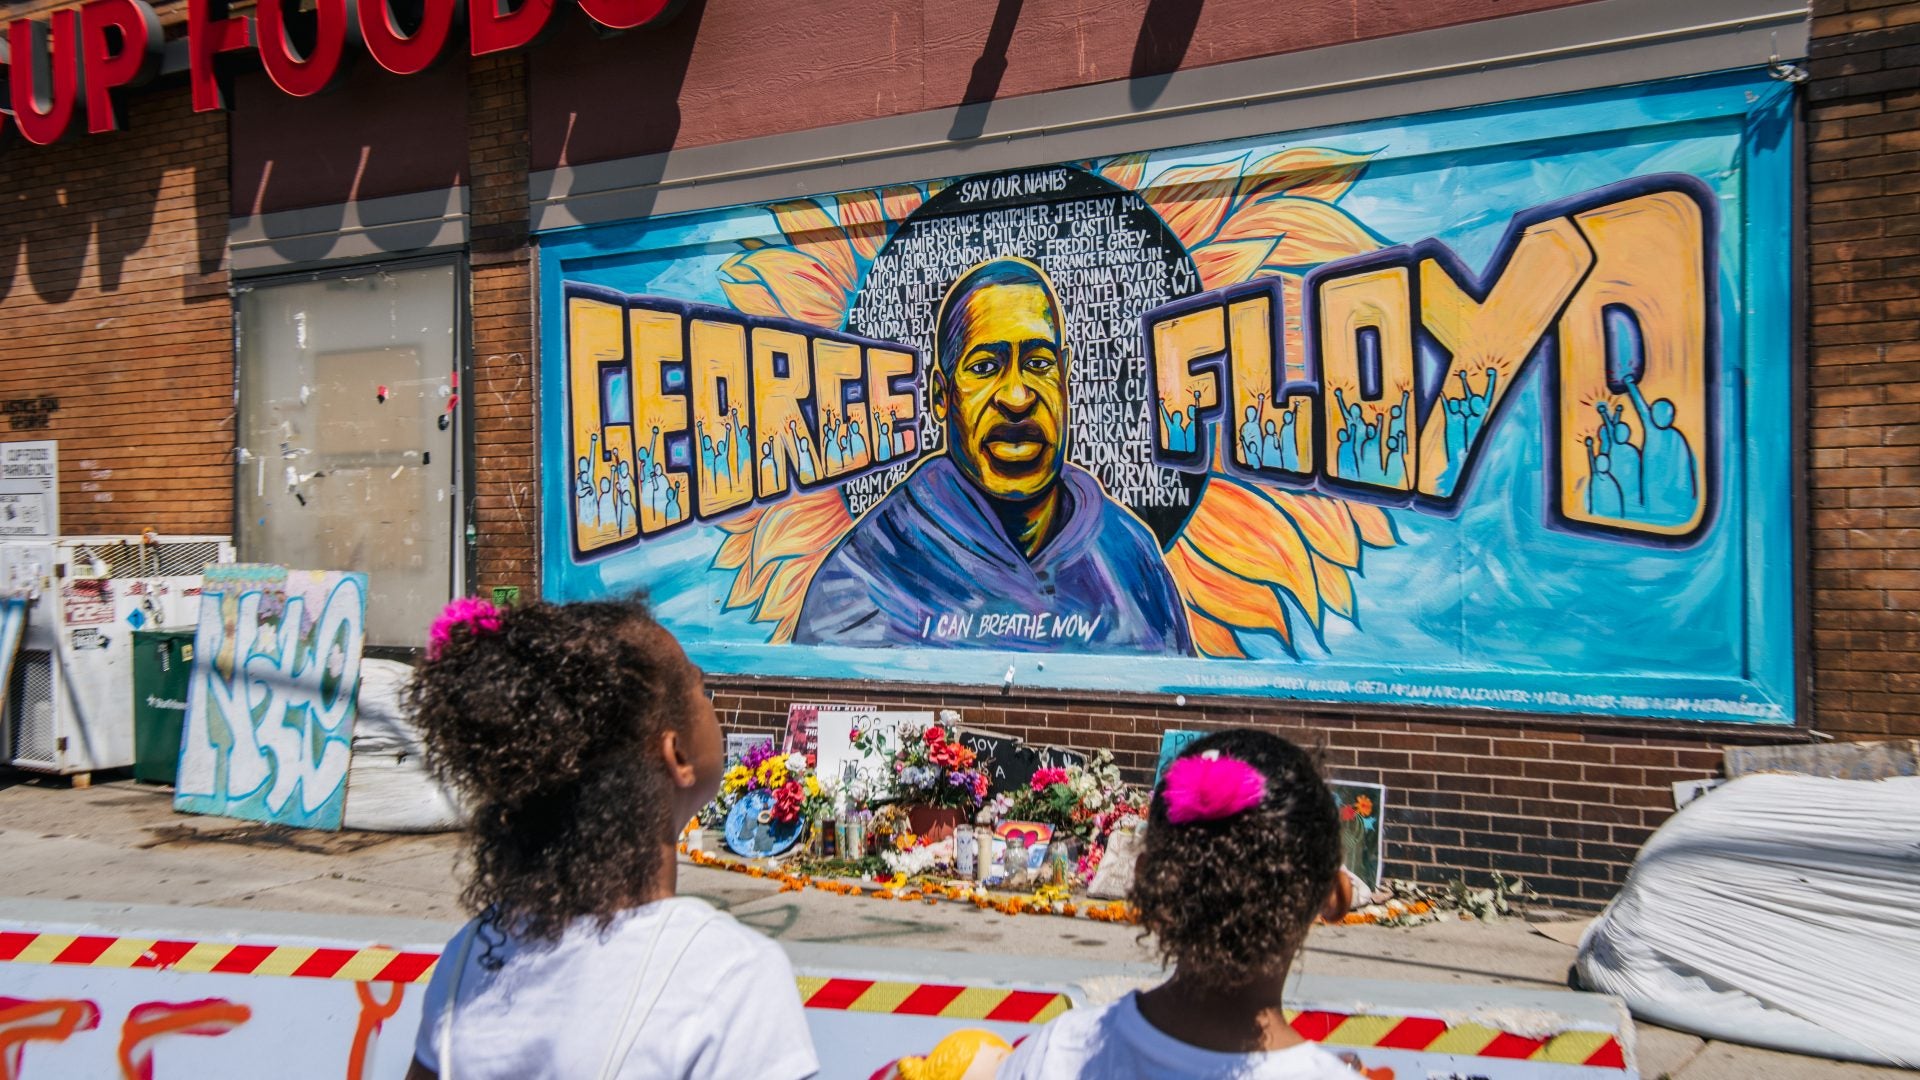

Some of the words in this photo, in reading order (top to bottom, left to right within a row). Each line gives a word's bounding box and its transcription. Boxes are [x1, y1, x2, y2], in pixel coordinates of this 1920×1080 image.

[0, 0, 144, 146] UP
[190, 0, 662, 113] FOO
[960, 179, 990, 203] SAY
[991, 175, 1022, 200] OUR
[1024, 168, 1067, 194] NAMES
[910, 214, 981, 239] TERRENCE
[983, 203, 1051, 230] CRUTCHER
[1055, 197, 1116, 223] JEREMY
[894, 235, 936, 256] TAMIR
[937, 233, 969, 252] RICE
[982, 222, 1058, 244] PHILANDO
[1071, 215, 1129, 237] CASTILE
[872, 254, 899, 274] AKAI
[900, 251, 942, 270] GURLEY
[942, 245, 991, 266] KENDRA
[991, 240, 1036, 258] JAMES
[1046, 234, 1106, 257] FREDDIE
[1107, 229, 1146, 250] GREY
[1036, 252, 1097, 272] TERRANCE
[1098, 247, 1162, 266] FRANKLIN
[866, 269, 921, 290] MICHAEL
[1050, 266, 1114, 289] BREONNA
[1112, 260, 1169, 283] TAYLOR
[1173, 256, 1195, 278] AL
[857, 286, 901, 308] TYISHA
[1057, 282, 1121, 306] SHANTEL
[1123, 278, 1166, 300] DAVIS
[849, 306, 877, 325] ERIC
[878, 302, 934, 322] GARNER
[1063, 301, 1121, 324] WALTER
[858, 319, 909, 339] SANDRA
[1065, 321, 1107, 342] REKIA
[566, 290, 918, 559] GEORGE
[1150, 182, 1709, 541] FLOYD
[1069, 359, 1122, 381] SHELLY
[1069, 381, 1121, 405] JAMAR
[1069, 402, 1136, 425] TANISHA
[1070, 422, 1125, 443] TARIKA
[1071, 440, 1120, 465] ALTON
[1111, 486, 1190, 508] KATHRYN
[921, 615, 931, 638] I
[937, 614, 973, 638] CAN
[976, 612, 1051, 638] BREATHE
[1051, 614, 1101, 642] NOW
[967, 736, 998, 757] JOY
[995, 765, 1006, 779] A
